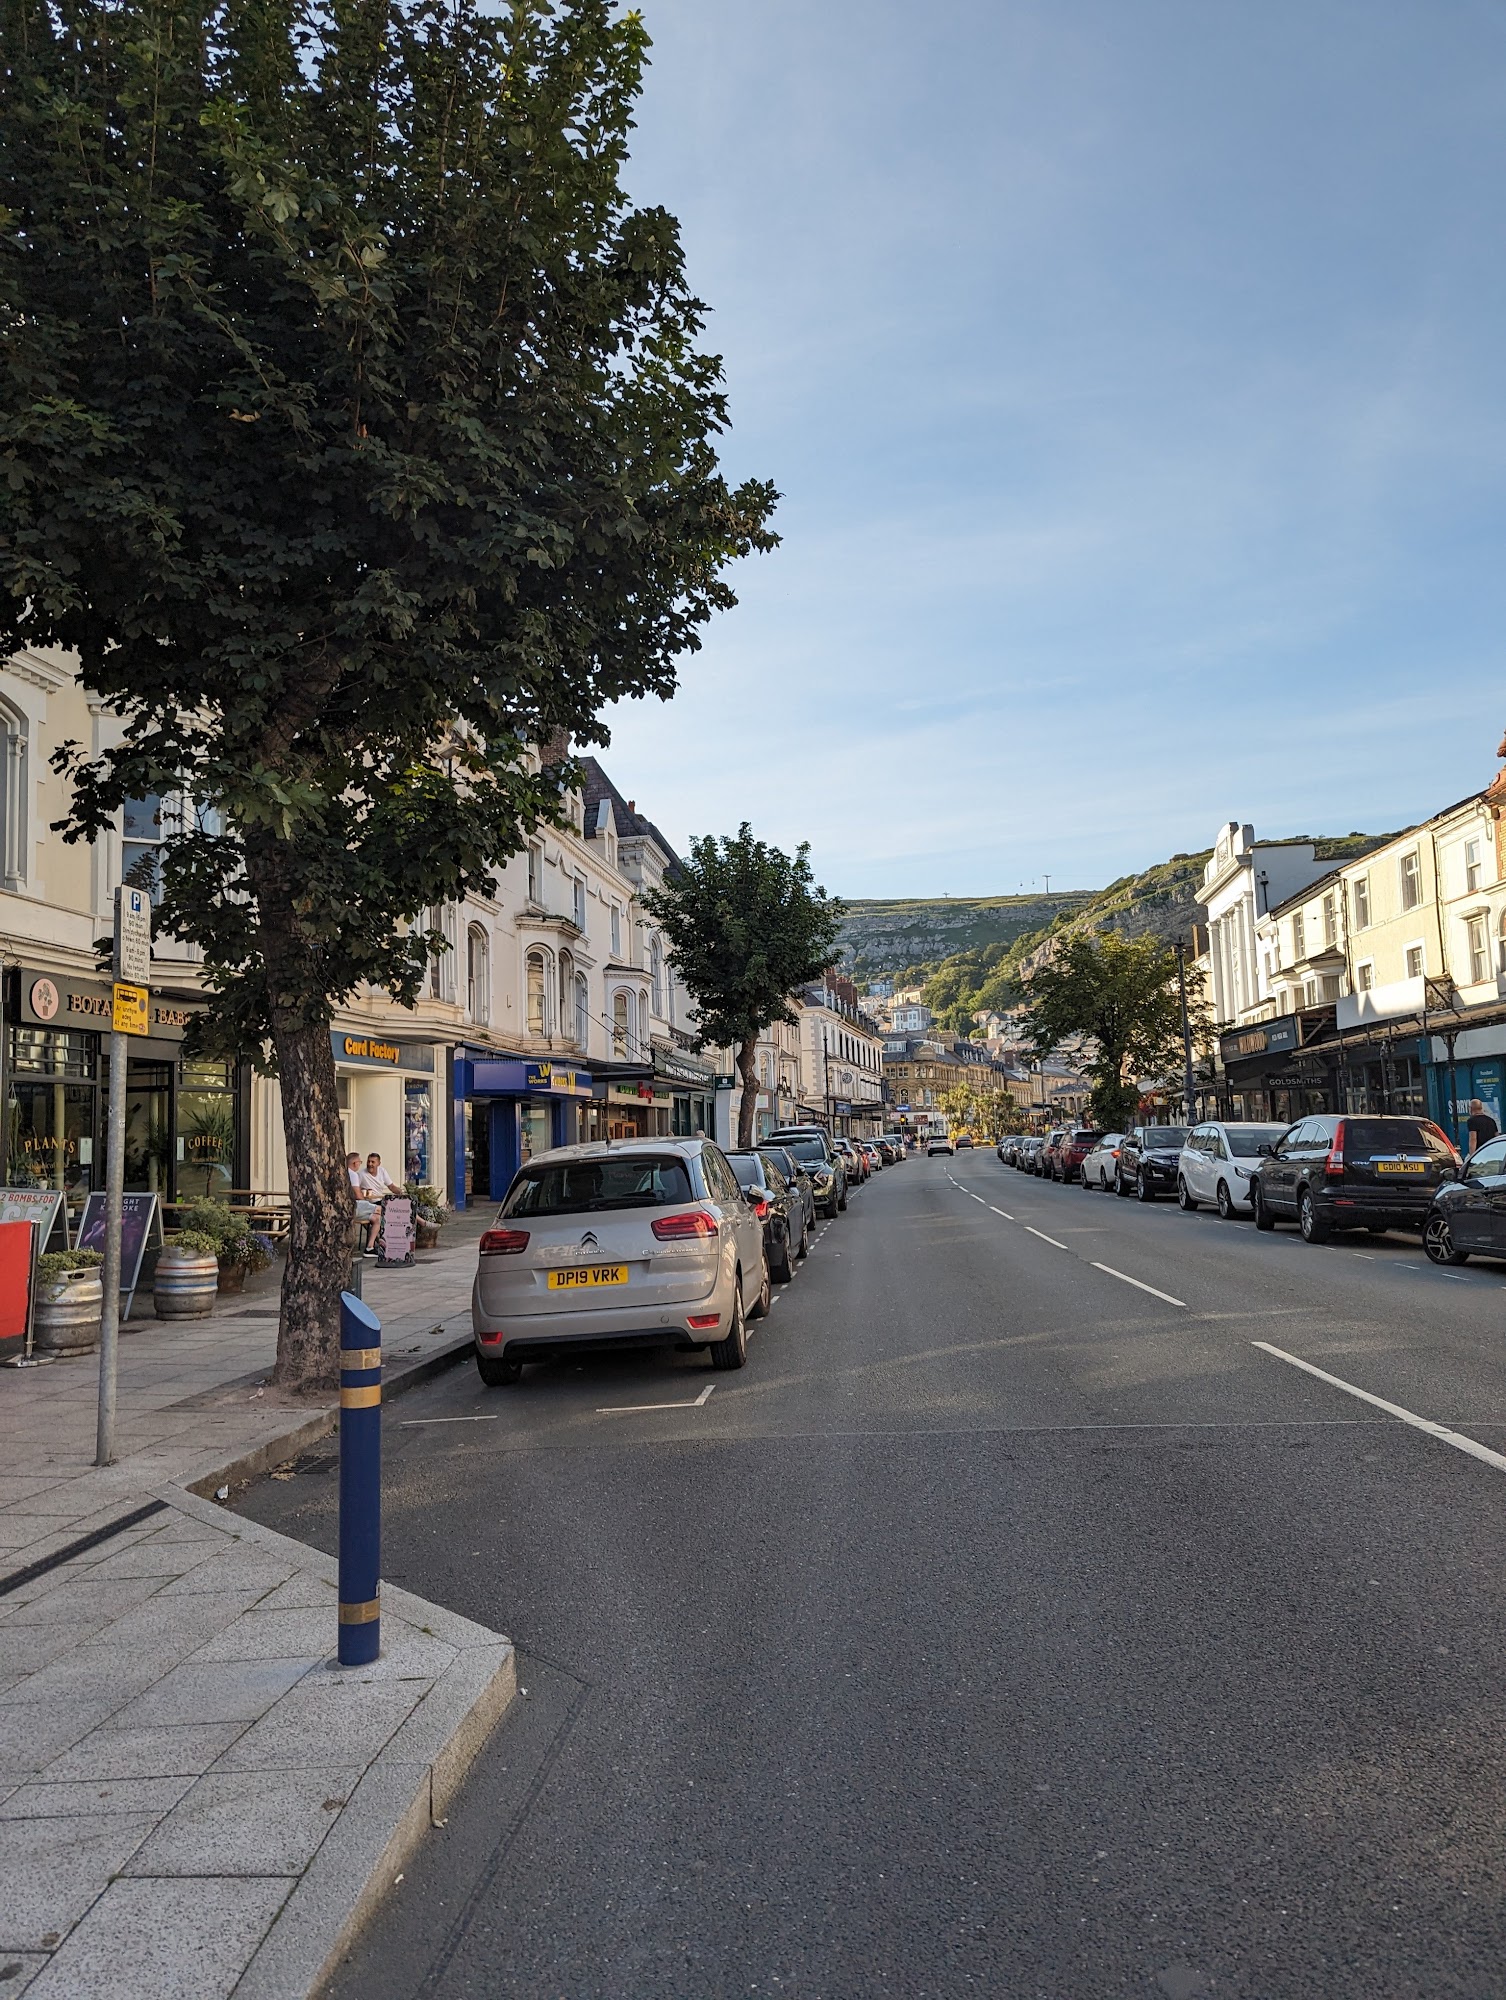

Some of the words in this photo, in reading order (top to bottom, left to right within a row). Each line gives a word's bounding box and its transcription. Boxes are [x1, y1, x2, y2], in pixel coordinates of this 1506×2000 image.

[133, 893, 140, 909] P
[345, 1036, 368, 1056] Card
[370, 1040, 399, 1064] Factory
[1448, 1099, 1470, 1115] SRRY
[24, 1136, 75, 1153] PLANTS
[188, 1135, 223, 1149] COFFEE
[1382, 1163, 1401, 1171] GD10
[1403, 1163, 1419, 1171] MSU
[8, 1193, 37, 1203] BOMBS
[39, 1195, 55, 1204] FOR
[556, 1270, 588, 1285] DP19
[592, 1268, 620, 1282] VRK
